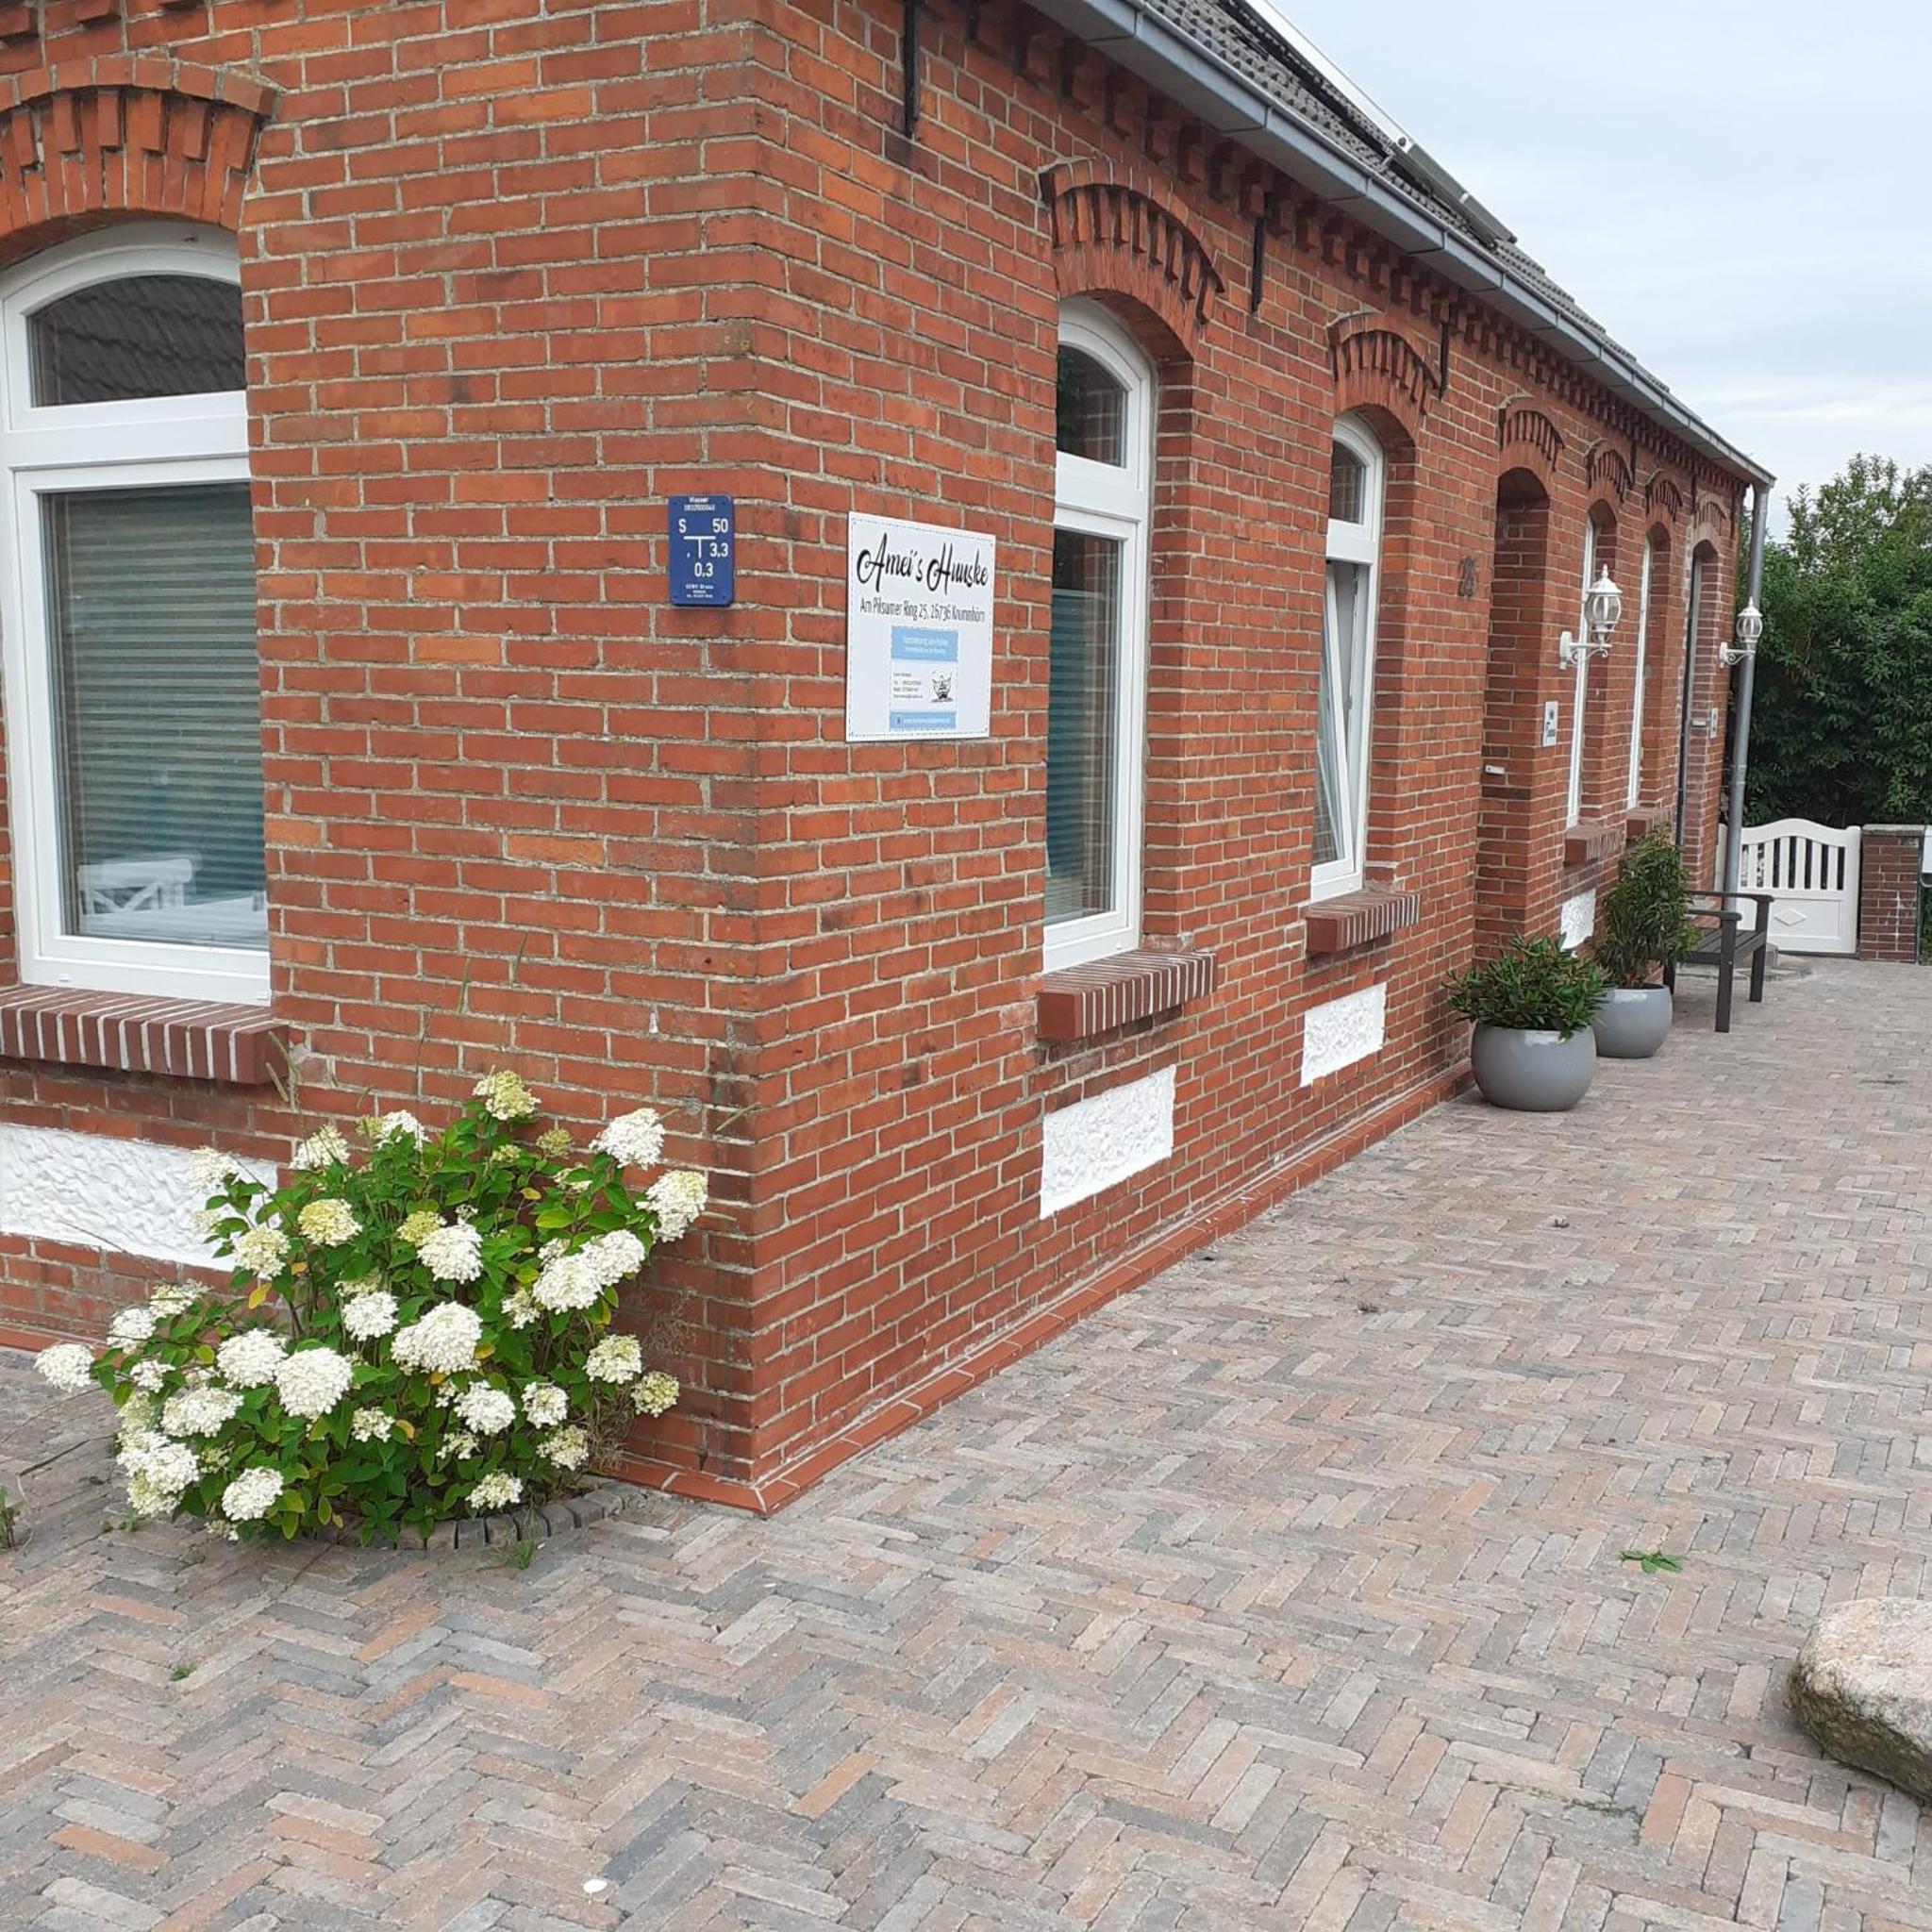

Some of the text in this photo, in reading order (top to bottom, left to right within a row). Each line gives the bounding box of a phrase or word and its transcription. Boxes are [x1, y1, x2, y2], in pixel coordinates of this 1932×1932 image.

[678, 518, 728, 534] S 50
[860, 597, 873, 613] Am
[904, 600, 917, 621] Ring
